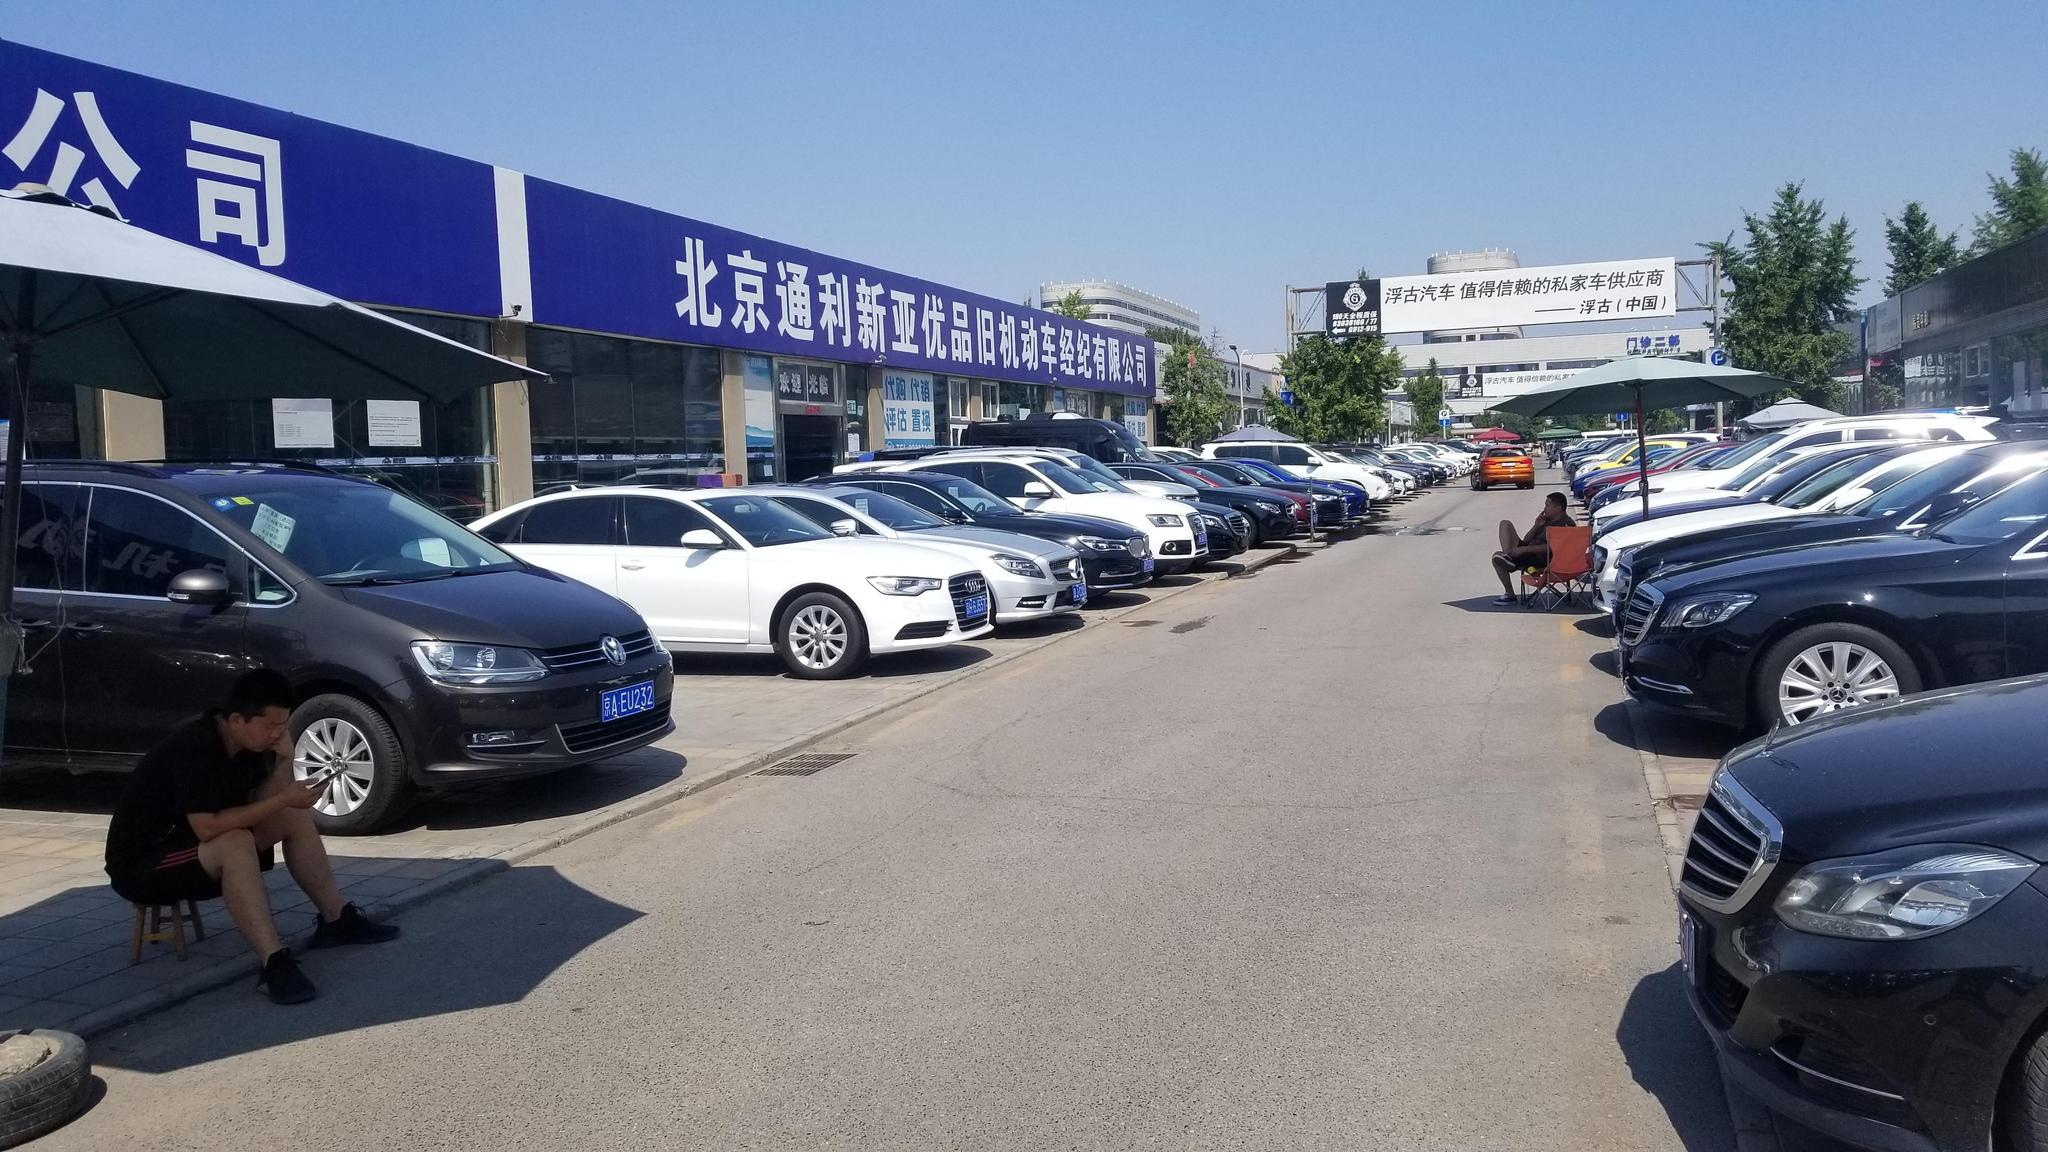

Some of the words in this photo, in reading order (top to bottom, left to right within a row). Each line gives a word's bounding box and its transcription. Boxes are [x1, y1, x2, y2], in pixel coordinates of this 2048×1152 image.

[2, 88, 286, 266] 公司
[675, 236, 1147, 388] 北京通利新亚优品旧机动车经纪有限公司
[1384, 283, 1456, 304] 浮古汽车
[1460, 269, 1665, 300] 值得信赖的私家车供应商
